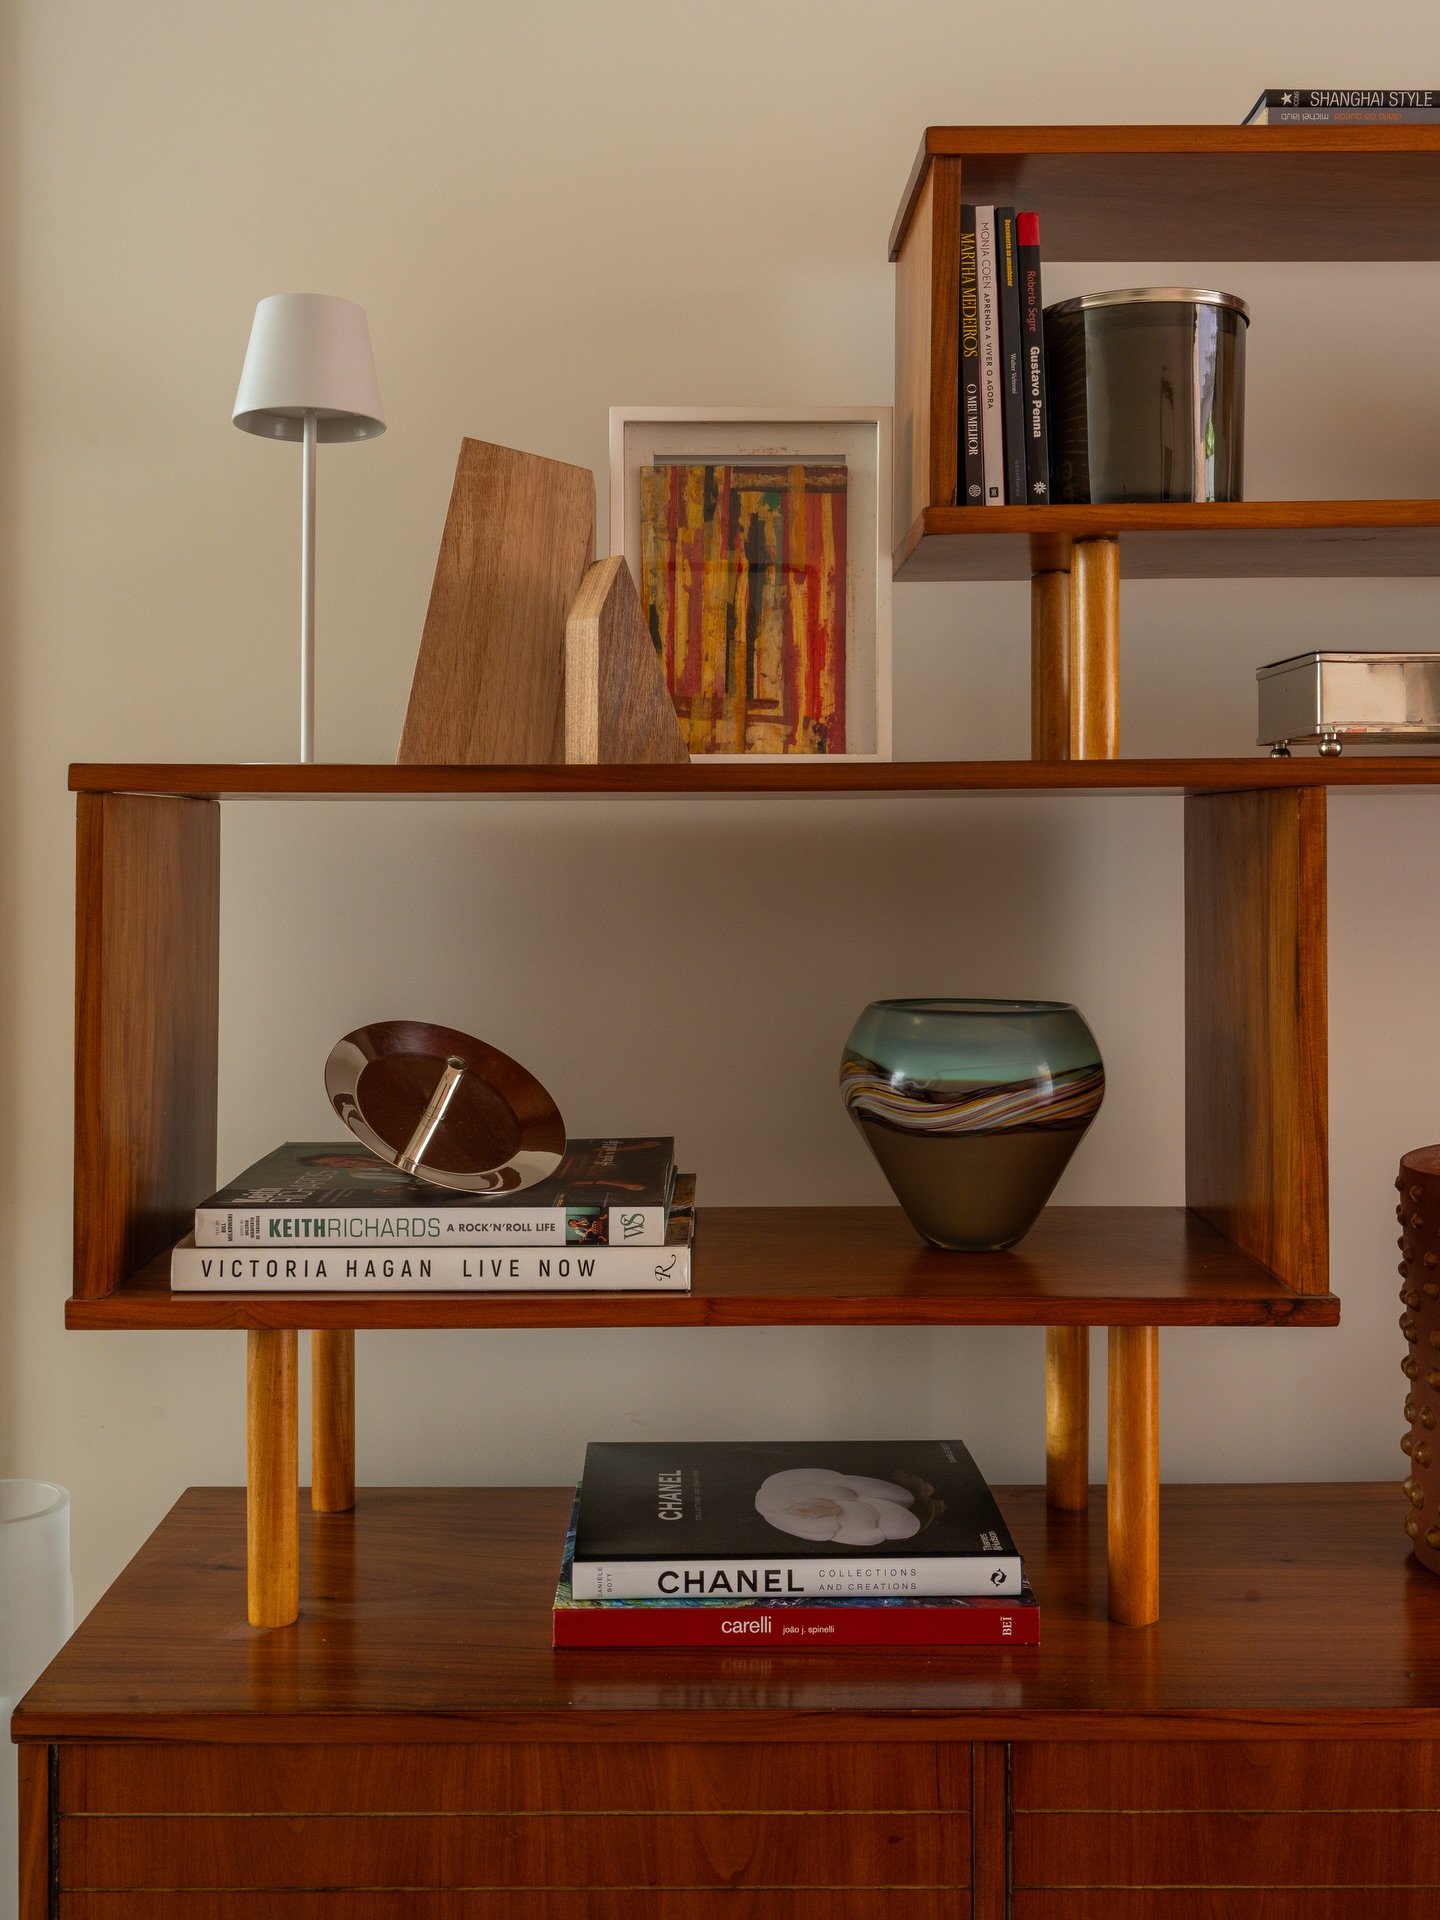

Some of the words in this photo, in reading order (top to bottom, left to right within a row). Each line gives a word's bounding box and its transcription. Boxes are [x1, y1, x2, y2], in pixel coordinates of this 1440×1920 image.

[1310, 91, 1384, 107] SHANGHAI
[1388, 91, 1433, 107] STYLE
[1280, 112, 1300, 121] laub
[1302, 112, 1329, 121] michel
[1334, 112, 1363, 121] queda
[981, 222, 990, 257] MONJA
[960, 233, 976, 284] MARTHA
[982, 260, 991, 288] COEN
[1027, 270, 1036, 305] Roberto
[962, 288, 978, 358] MEDEIROS
[984, 293, 992, 332] APRENDA
[1027, 308, 1038, 332] Segre
[1030, 346, 1040, 396] Gustavo
[966, 384, 977, 394] O
[986, 380, 994, 409] AGORA
[966, 396, 978, 415] MEU
[1032, 400, 1042, 438] Penna
[967, 416, 978, 456] MELHOR
[446, 1224, 454, 1232] A
[536, 1223, 556, 1232] LIFE
[201, 1259, 328, 1278] VICTORIA
[346, 1259, 432, 1278] HAGAN
[463, 1259, 520, 1278] LIVE
[539, 1259, 596, 1278] NOW
[658, 1470, 683, 1520] CHANEL
[658, 1569, 804, 1594] CHANEL
[818, 1568, 917, 1578] COLLECTIONS
[818, 1583, 842, 1591] AND
[848, 1582, 917, 1591] CREATIONS
[721, 1616, 771, 1634] carelli
[782, 1625, 800, 1635] joão
[808, 1625, 834, 1635] spinelli
